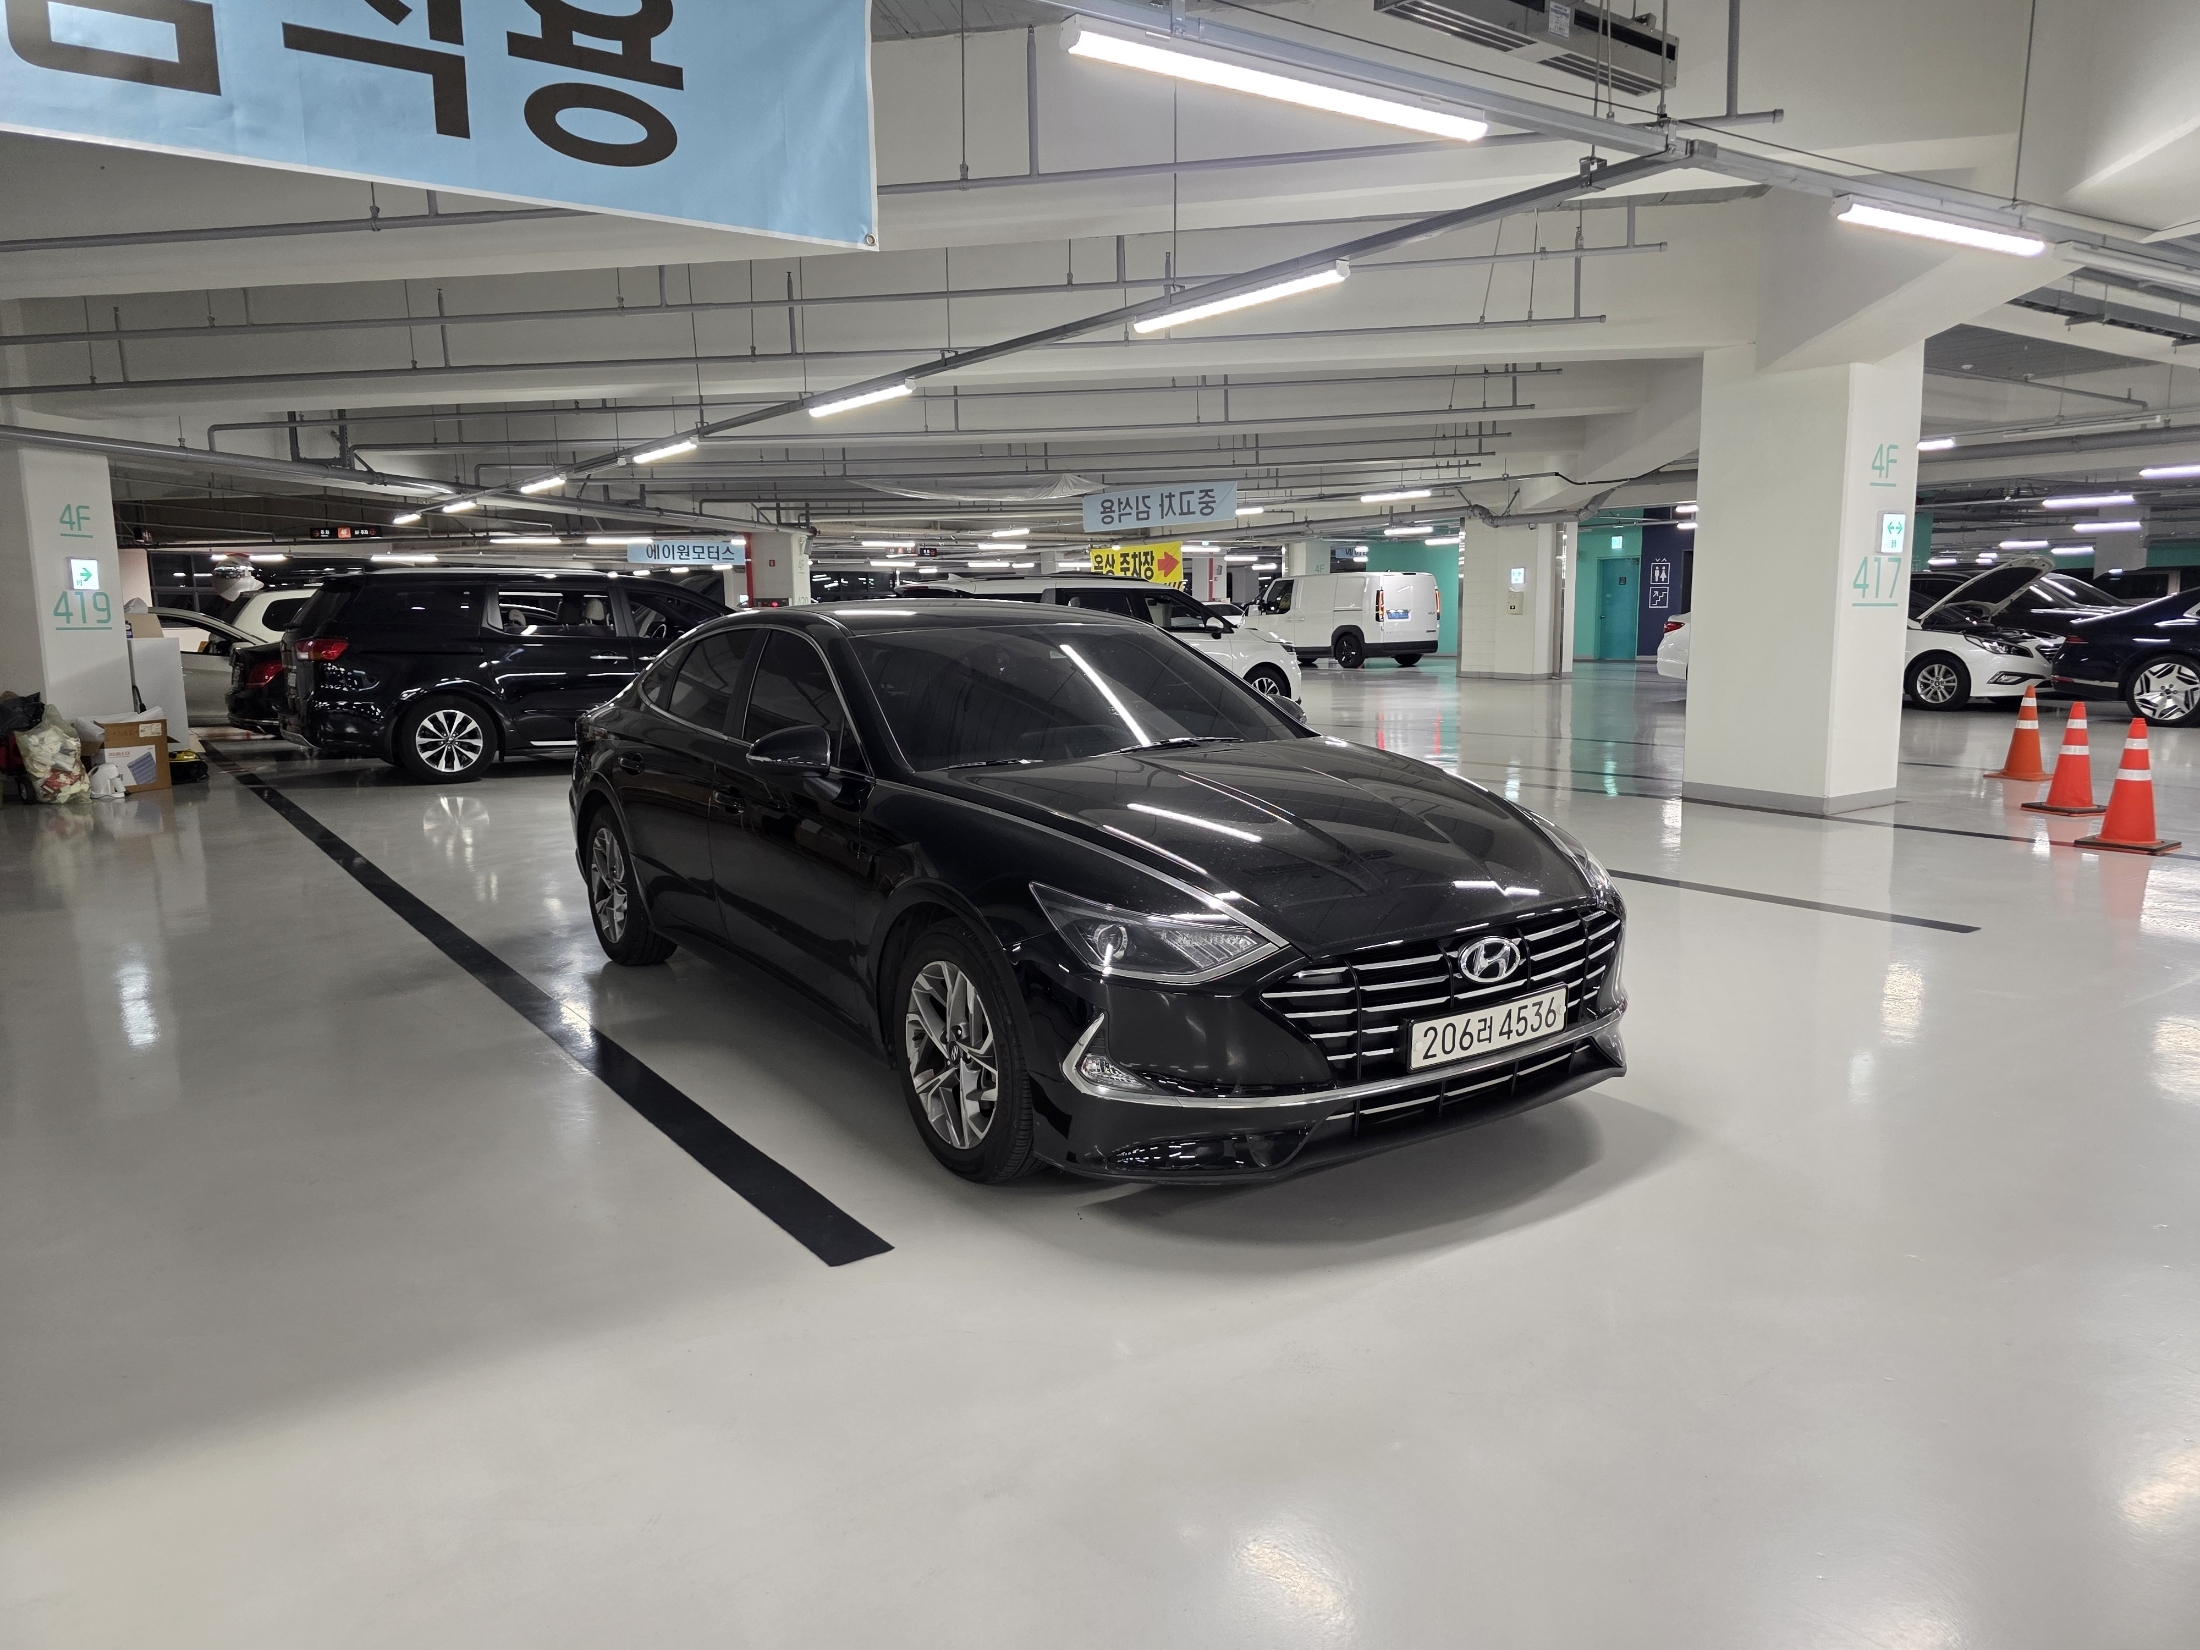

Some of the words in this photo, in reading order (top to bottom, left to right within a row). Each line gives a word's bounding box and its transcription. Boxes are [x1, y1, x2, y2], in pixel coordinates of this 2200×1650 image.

[1871, 443, 1899, 479] 4F
[59, 503, 91, 531] 4F
[646, 543, 735, 561] 에이원모터스
[1119, 550, 1155, 581] 주차장
[1314, 563, 1325, 573] 4F
[1852, 556, 1902, 599] 417
[53, 590, 112, 624] 419
[1422, 1016, 1493, 1060] 206러
[1498, 996, 1557, 1040] 4536
